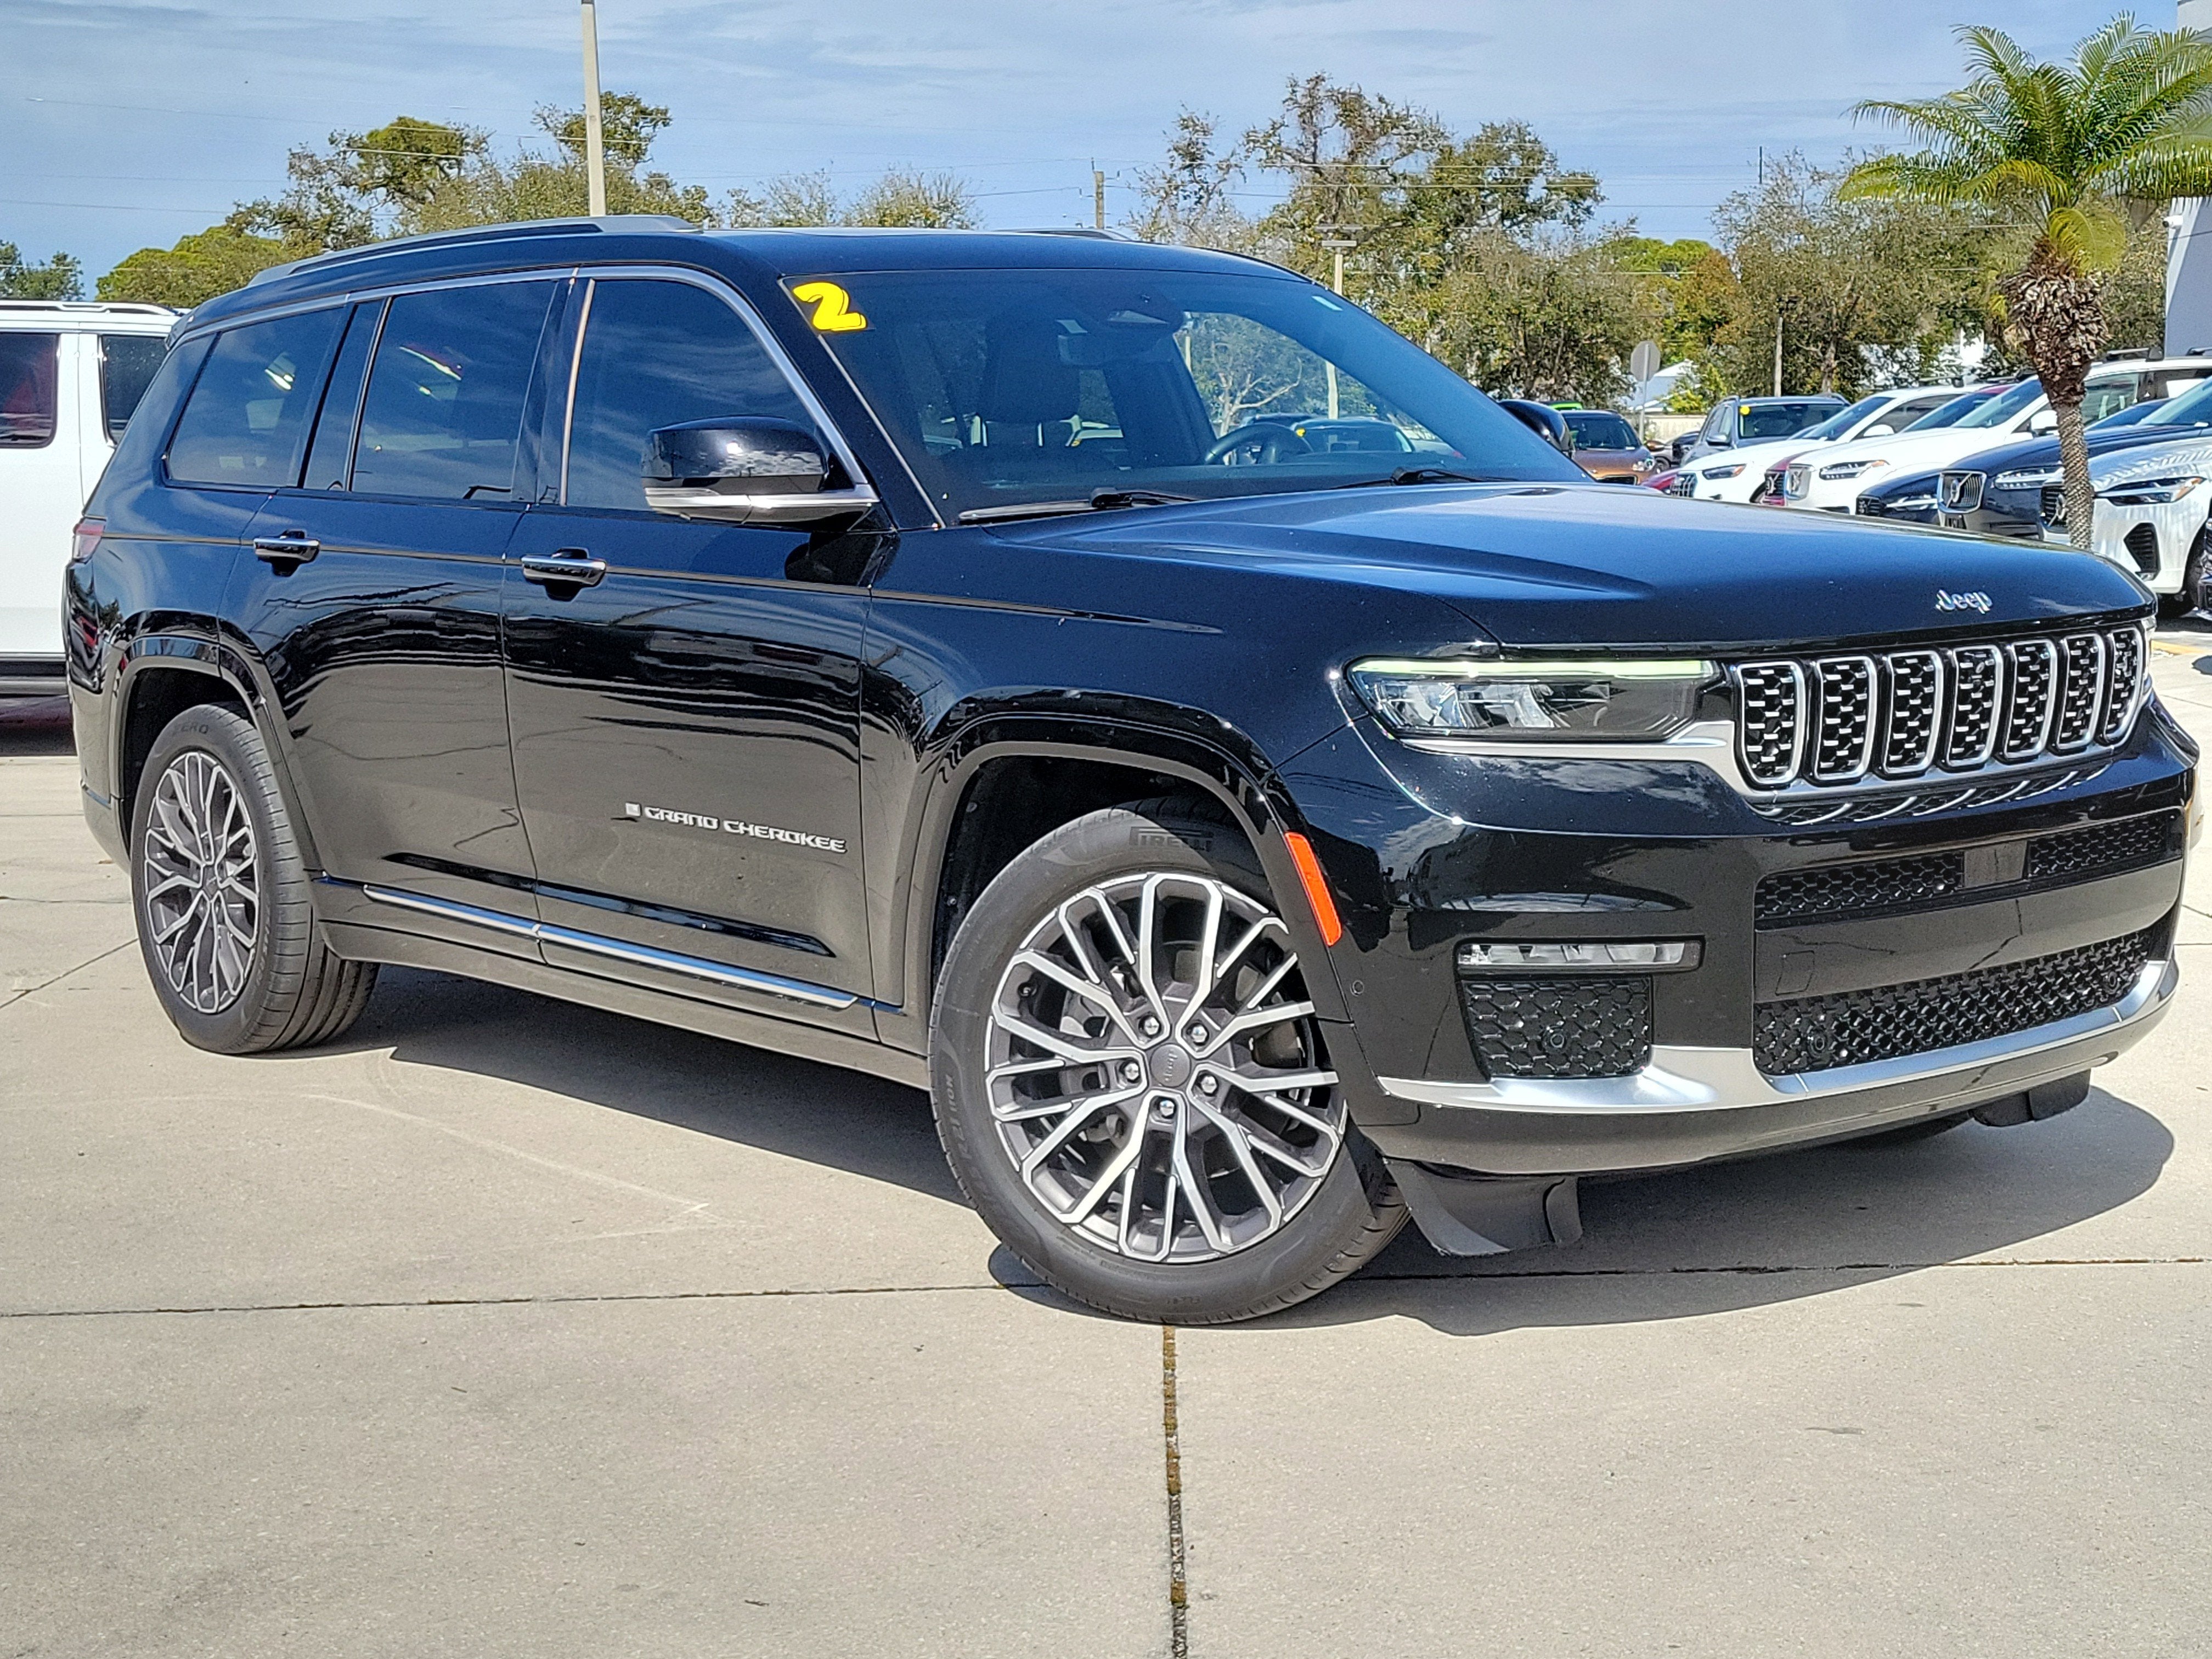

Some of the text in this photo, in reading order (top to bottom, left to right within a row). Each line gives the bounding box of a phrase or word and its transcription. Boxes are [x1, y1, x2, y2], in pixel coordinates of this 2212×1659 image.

[793, 281, 866, 331] 2
[1935, 589, 1993, 614] Jeep
[644, 806, 847, 854] GRAND CHEROKEE
